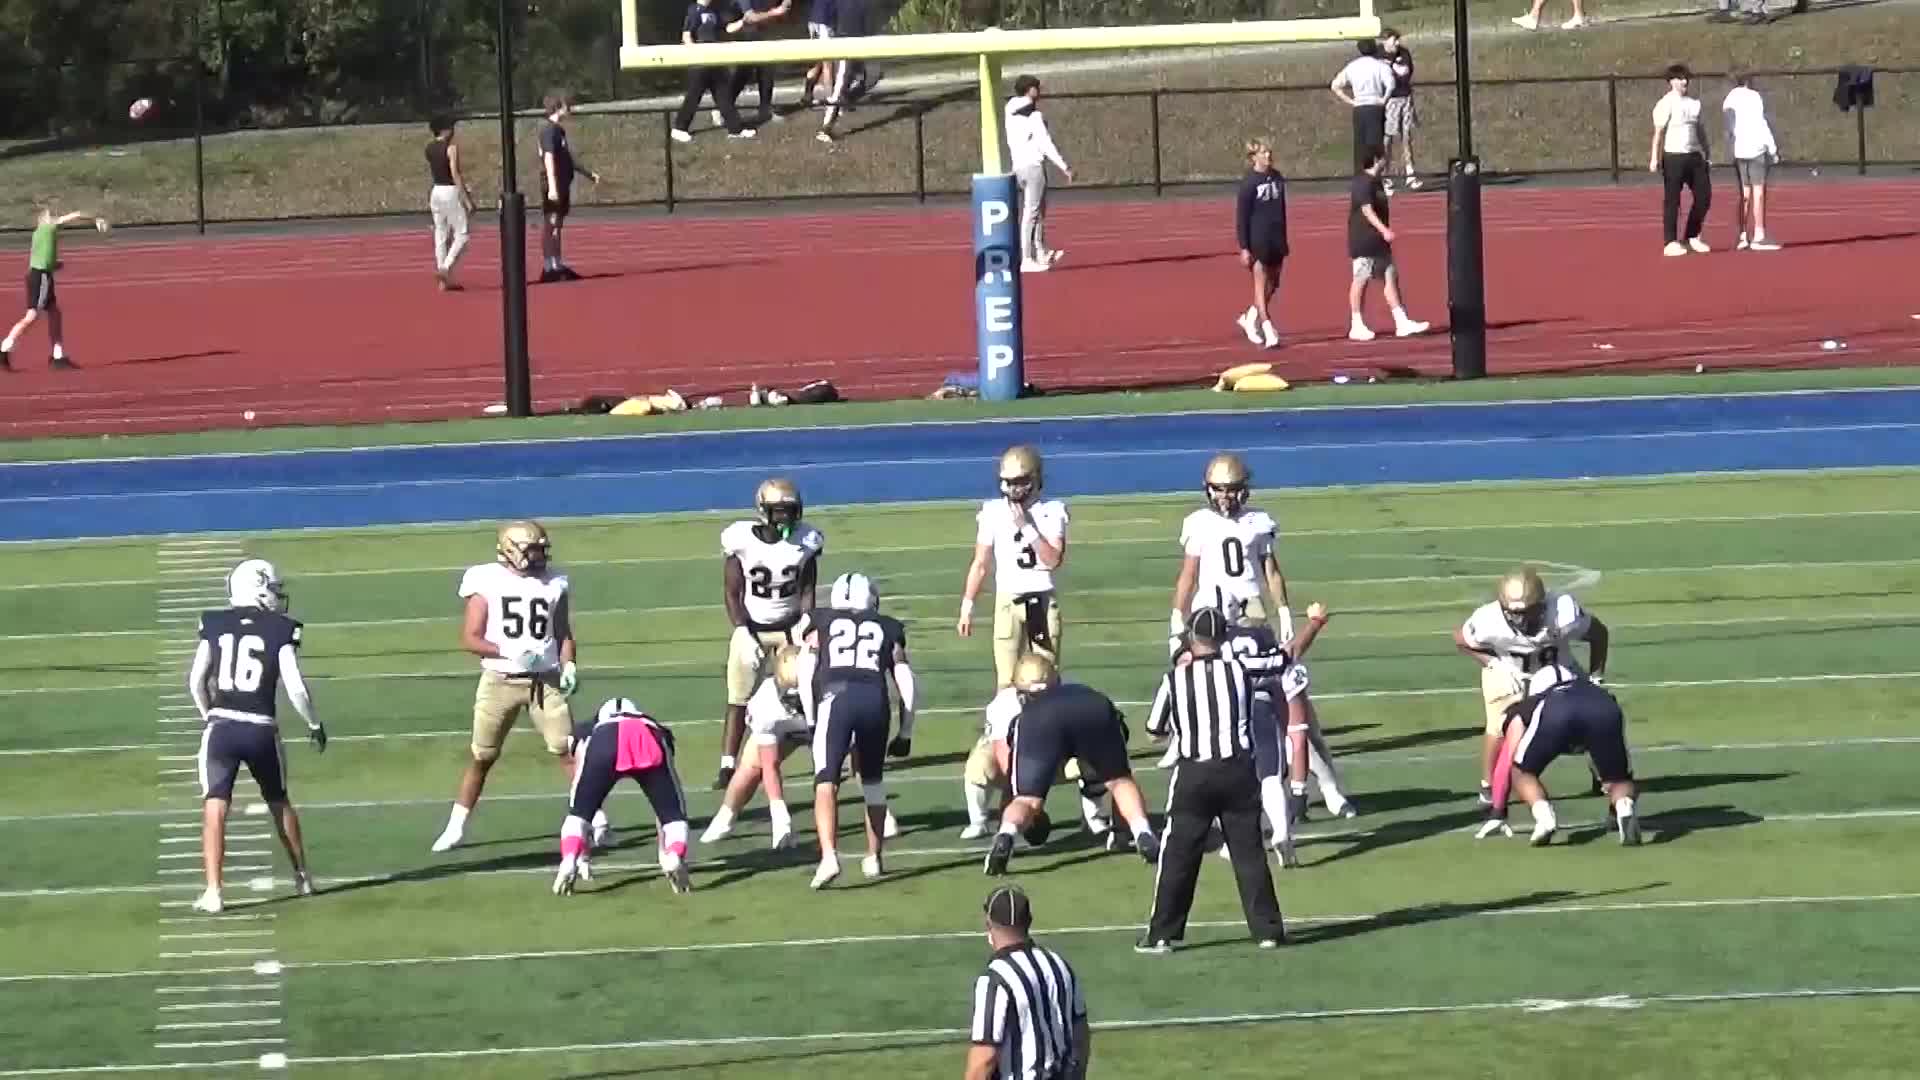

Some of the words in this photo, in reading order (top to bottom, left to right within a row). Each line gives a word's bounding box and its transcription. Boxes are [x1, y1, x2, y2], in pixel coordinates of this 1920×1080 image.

[982, 201, 1013, 380] PREP
[1014, 529, 1037, 569] 3
[1222, 537, 1244, 577] 0
[501, 596, 549, 639] 56
[218, 633, 264, 692] 16
[828, 618, 884, 671] 22
